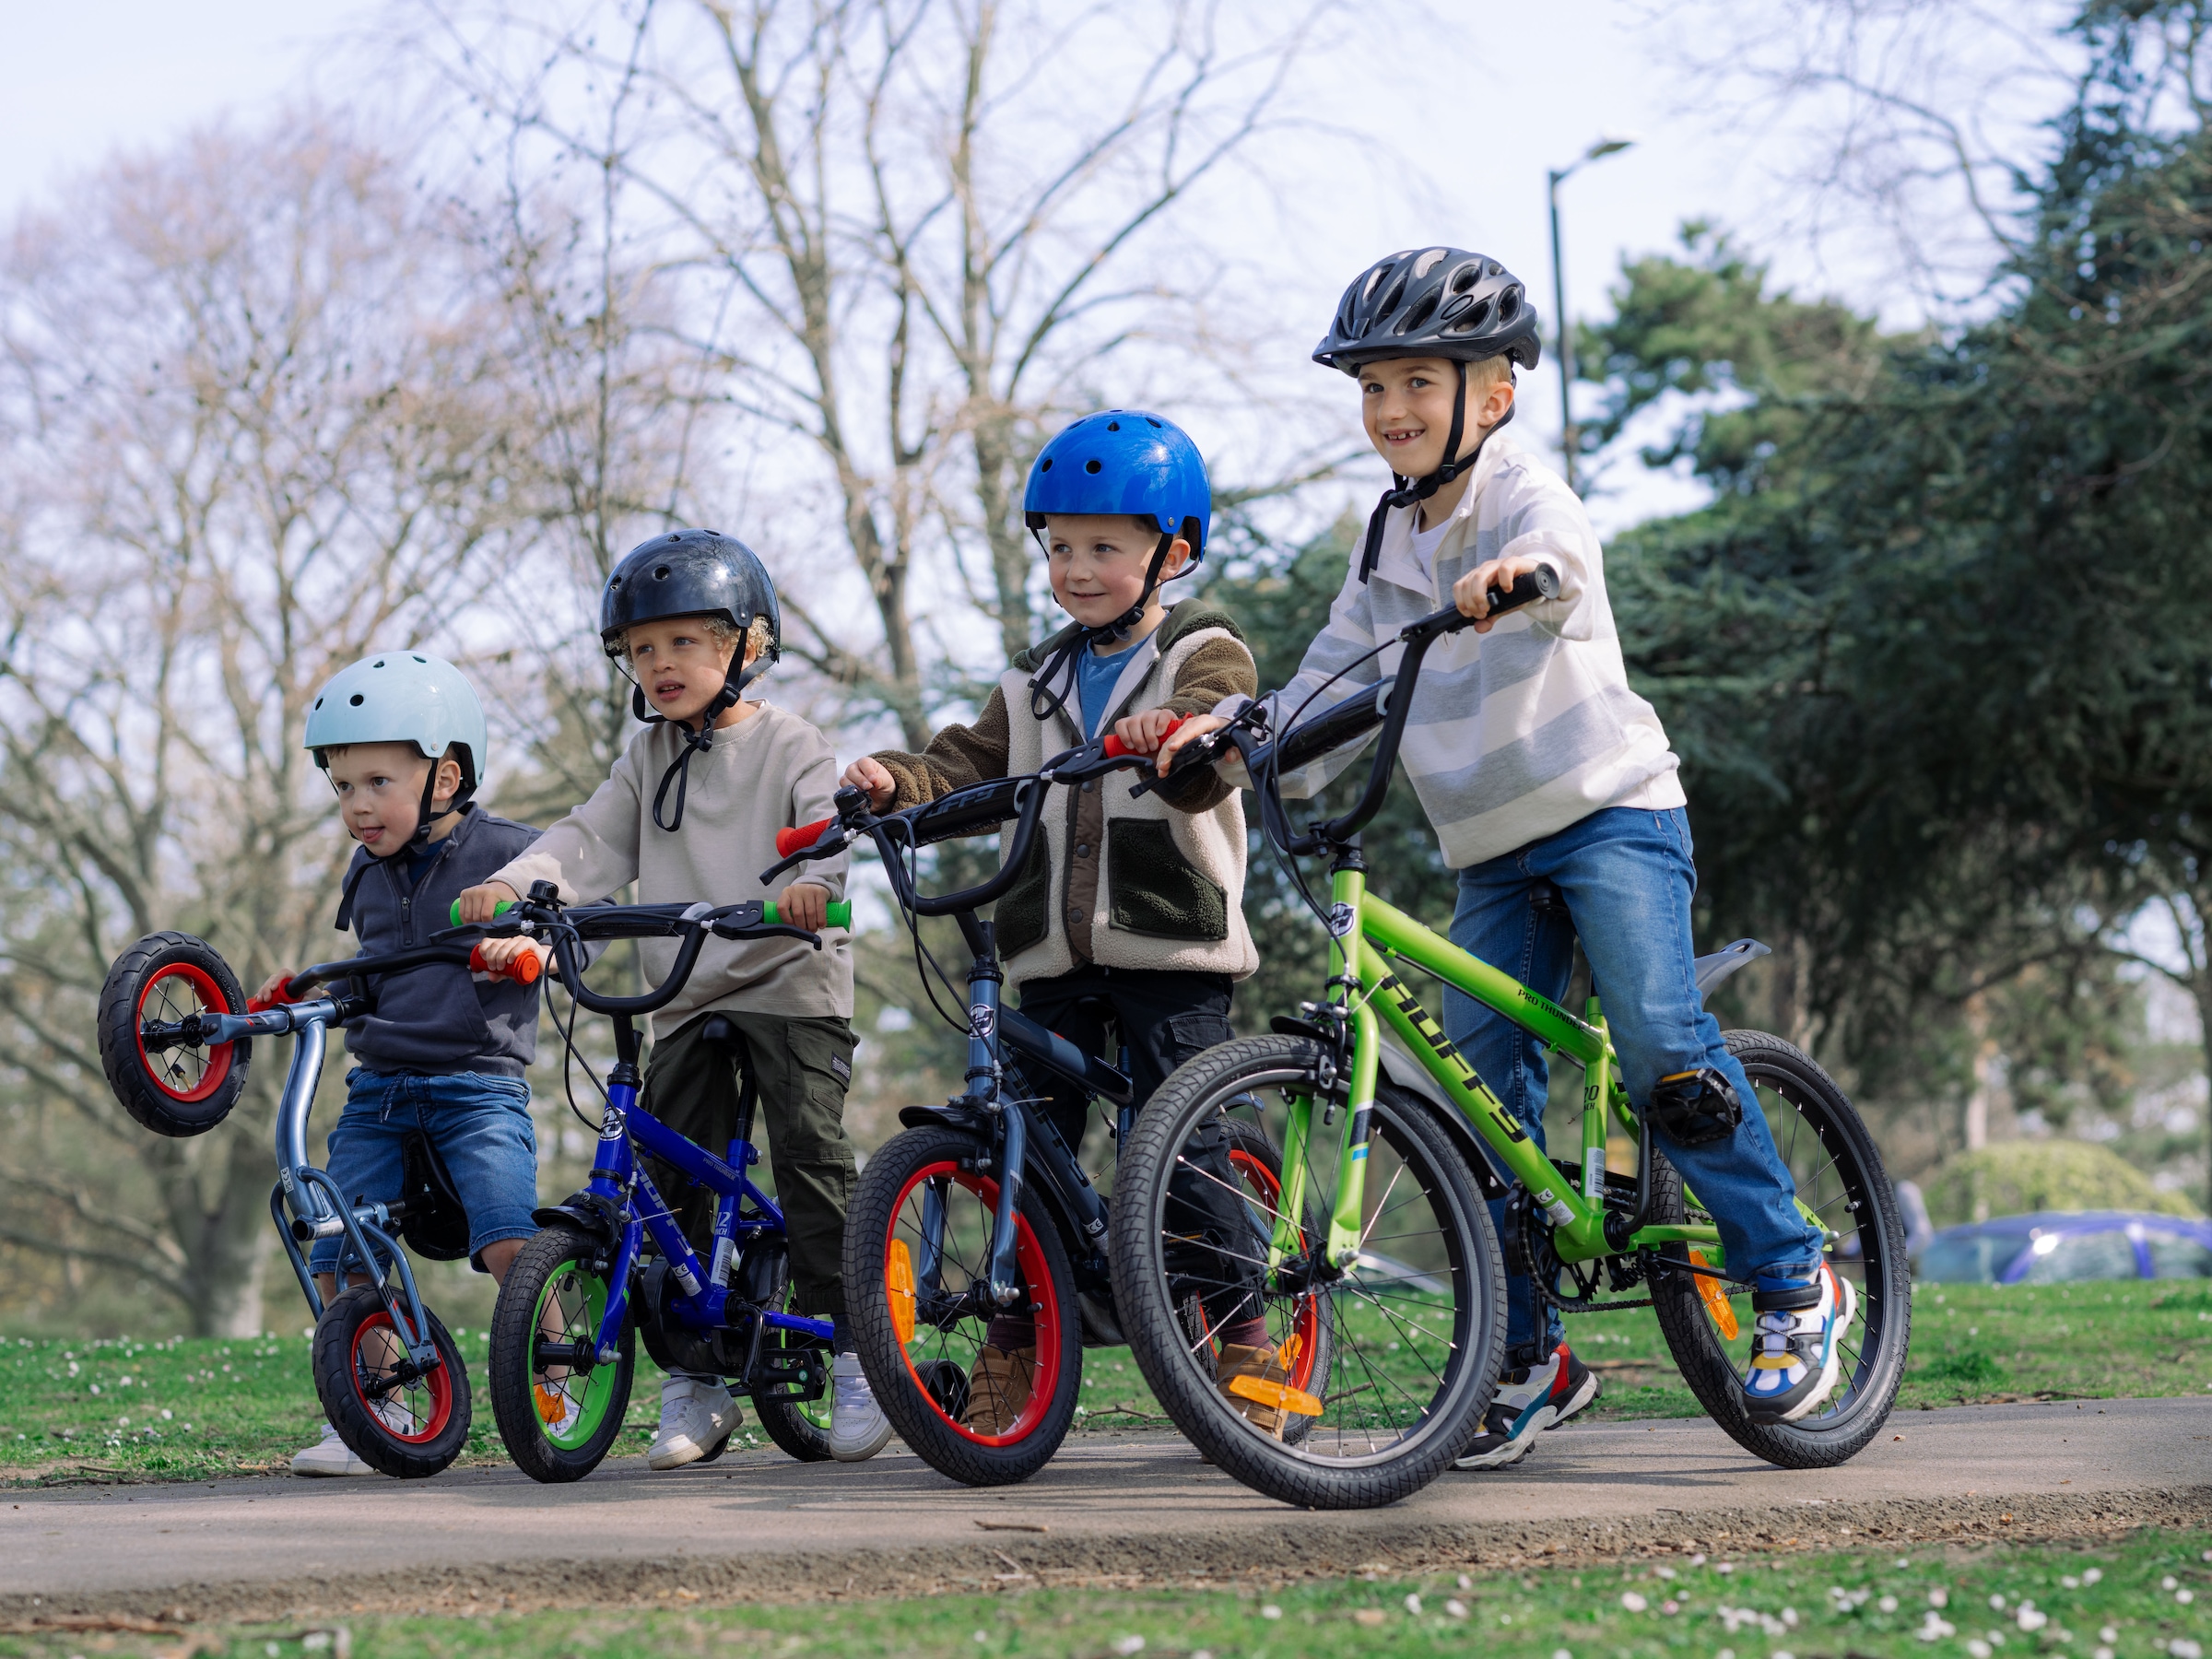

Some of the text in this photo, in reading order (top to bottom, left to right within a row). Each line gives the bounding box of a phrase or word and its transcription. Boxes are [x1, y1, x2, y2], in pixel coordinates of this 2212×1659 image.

[1517, 989, 1585, 1033] PRO THUNDER
[1380, 974, 1528, 1143] HUFFY
[714, 1228, 728, 1236] NCH
[715, 1211, 732, 1227] 12
